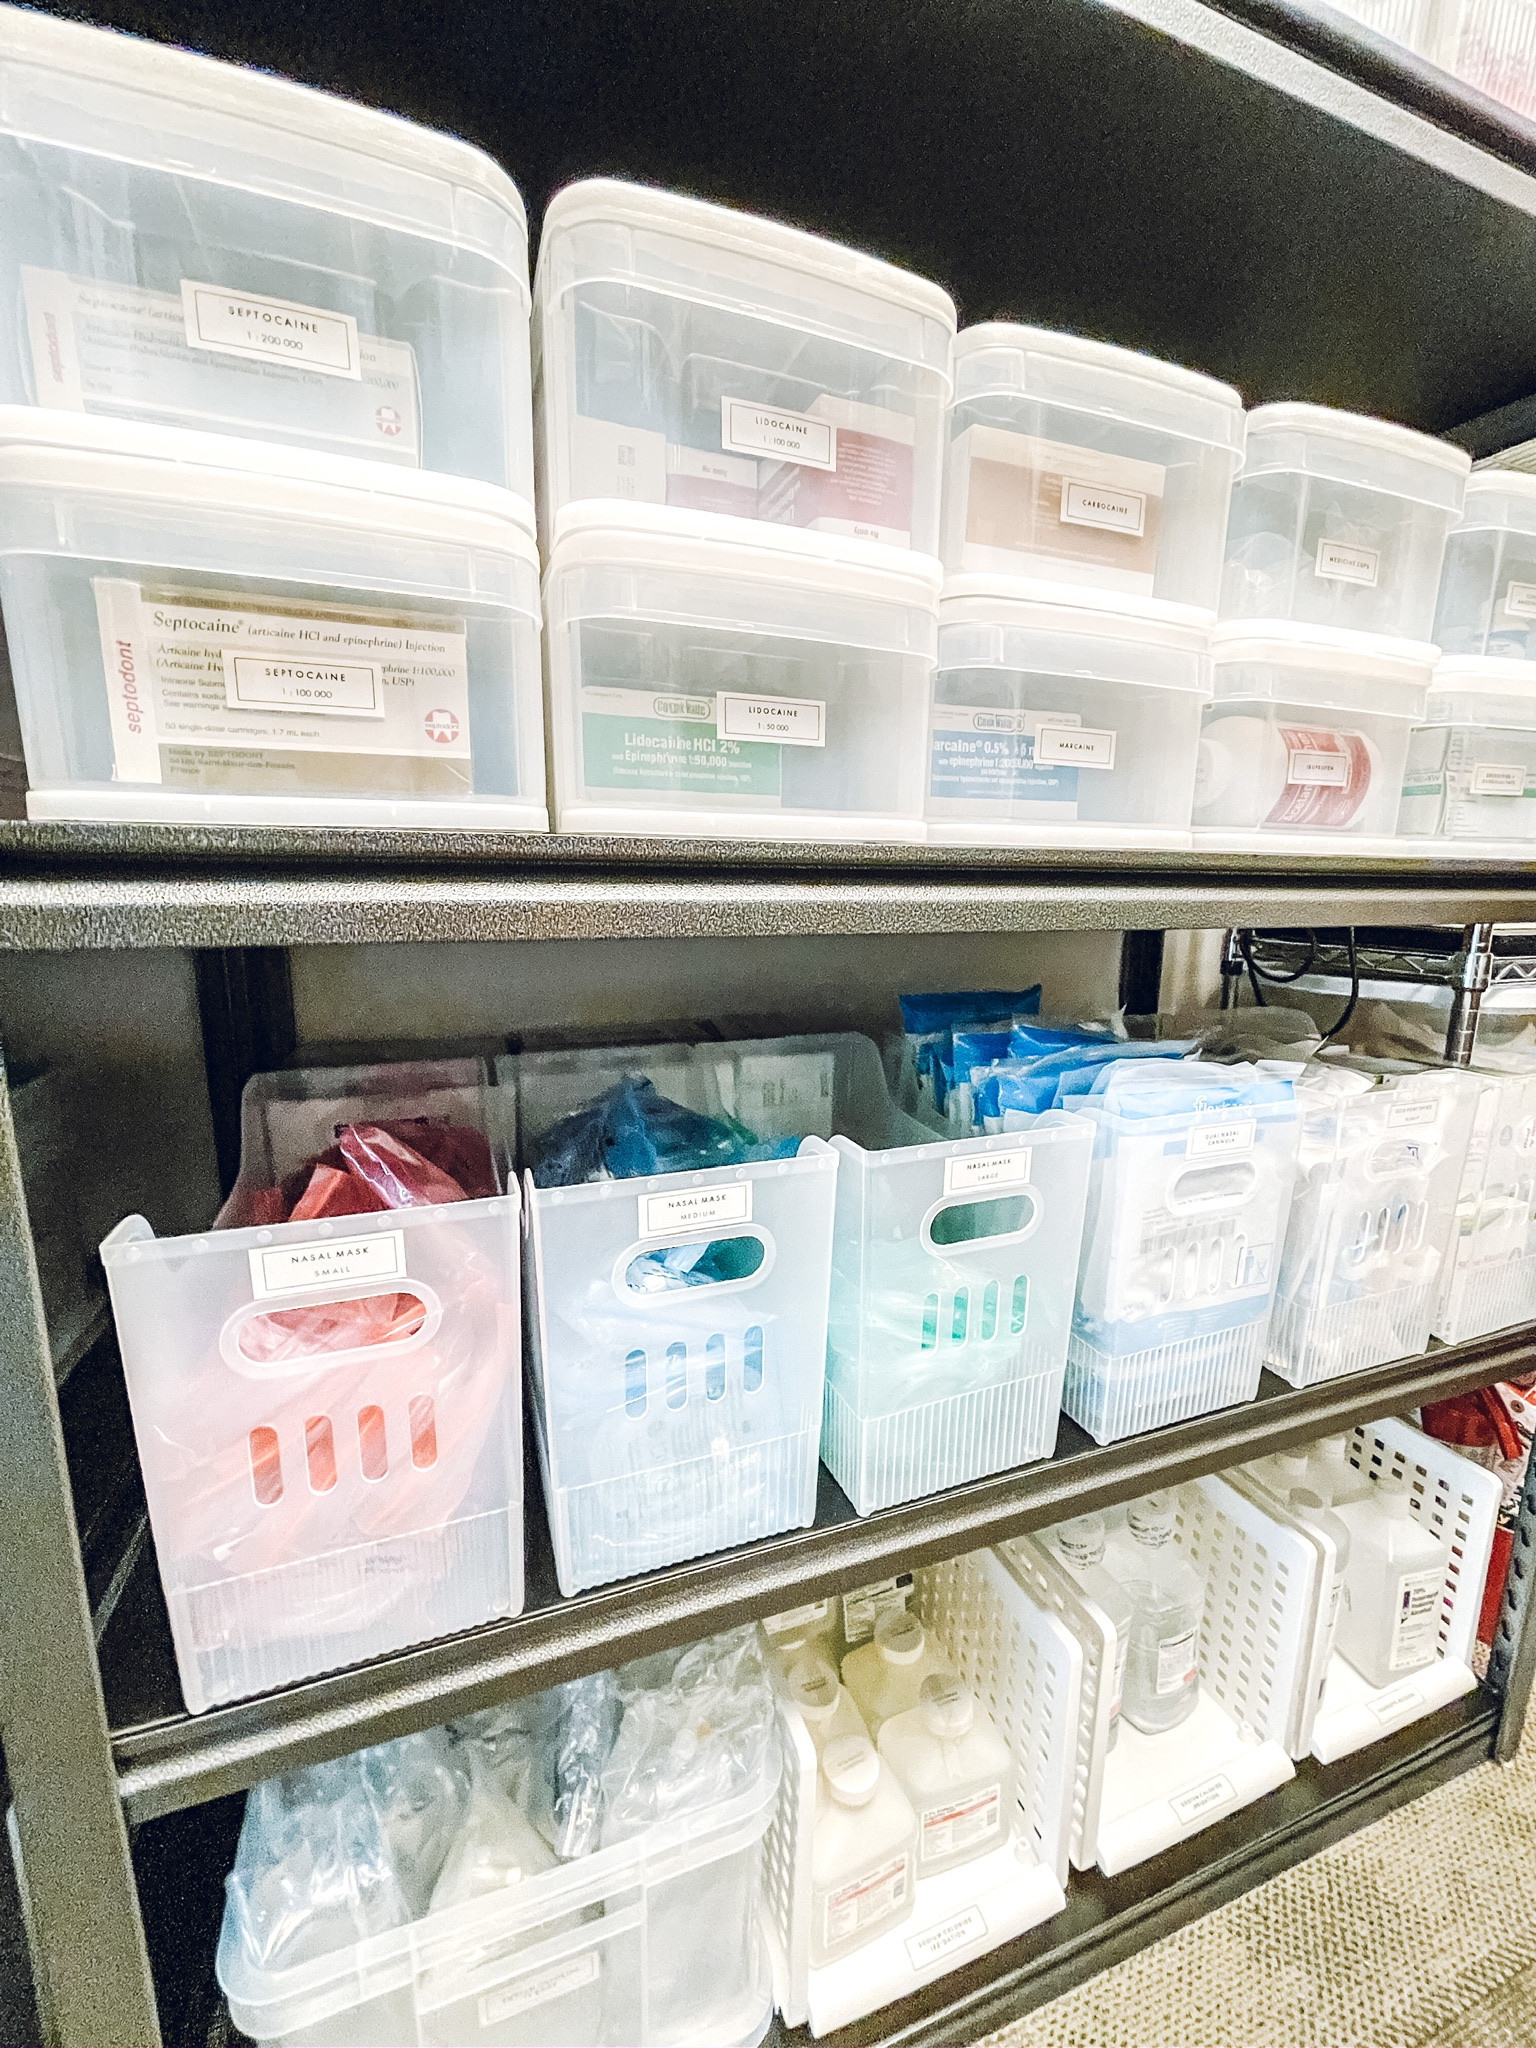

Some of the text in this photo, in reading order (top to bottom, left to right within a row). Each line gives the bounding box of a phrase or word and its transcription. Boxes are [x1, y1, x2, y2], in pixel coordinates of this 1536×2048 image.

[228, 306, 319, 333] SEPTOCAINE
[755, 416, 807, 435] LIDOCAINE
[1082, 499, 1128, 514] CARBOCAINE
[323, 633, 341, 644] and
[405, 640, 446, 653] Injection
[264, 668, 346, 682] SEPTOCAINE
[116, 640, 144, 734] septodont
[295, 688, 312, 697] 100
[314, 690, 332, 699] 000
[748, 706, 798, 717] LIDOCAINE
[624, 732, 691, 750] Lidocaine
[719, 740, 740, 754] 2%
[1059, 742, 1094, 751] MARCAINE
[967, 1159, 1011, 1170] NASAL MASK
[978, 1172, 998, 1181] LARGE
[668, 1194, 726, 1208] NASAL MASK
[680, 1210, 716, 1220] MEDIUM
[291, 1246, 369, 1264] NASAL MASK
[314, 1266, 351, 1277] SMALL
